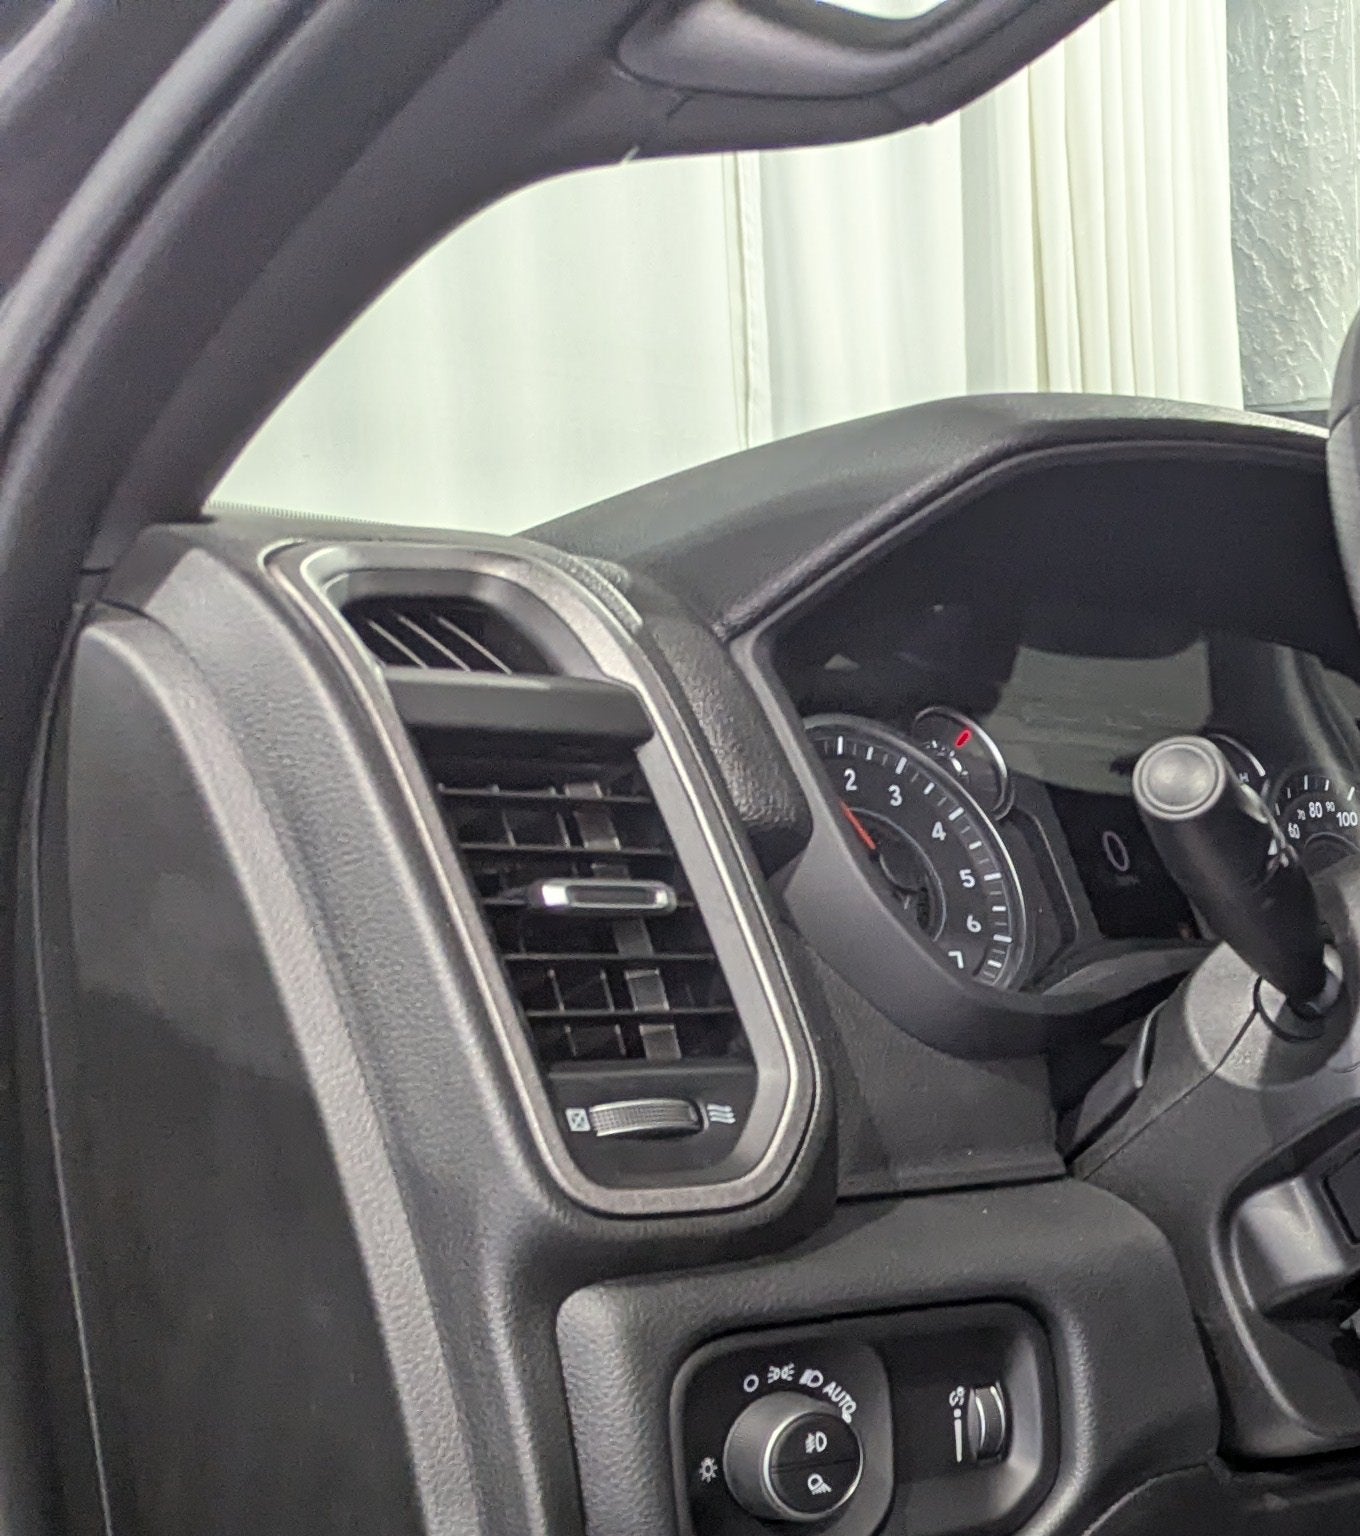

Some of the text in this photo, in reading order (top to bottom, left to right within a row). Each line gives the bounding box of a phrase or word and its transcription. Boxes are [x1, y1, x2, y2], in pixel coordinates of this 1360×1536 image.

[843, 768, 857, 791] 2
[888, 784, 902, 806] 3
[1308, 802, 1323, 818] 80
[1336, 811, 1358, 827] 100
[931, 821, 946, 841] 4
[959, 869, 975, 888] 5
[966, 915, 982, 933] 6
[823, 1382, 857, 1414] AUTO
